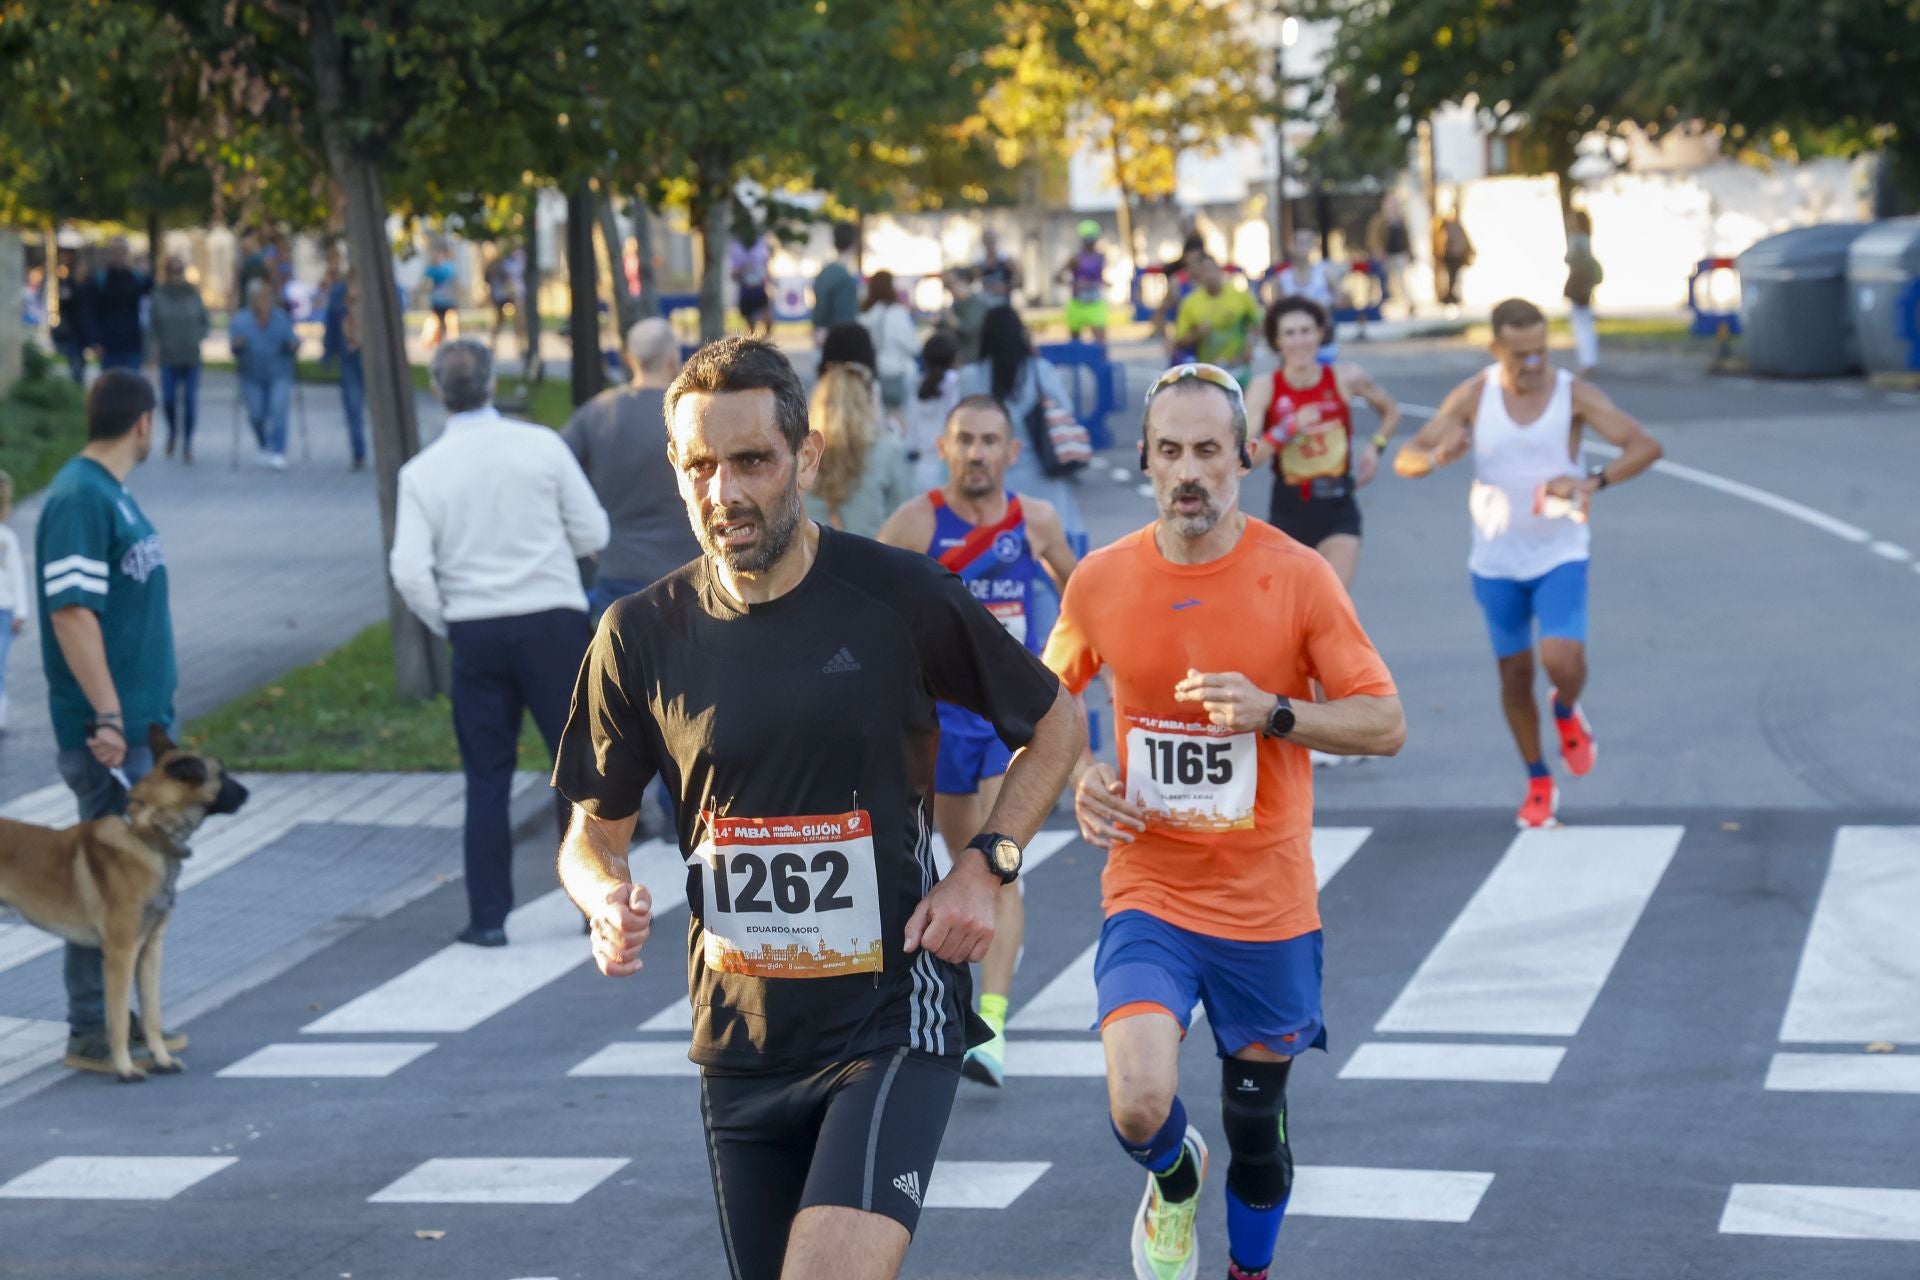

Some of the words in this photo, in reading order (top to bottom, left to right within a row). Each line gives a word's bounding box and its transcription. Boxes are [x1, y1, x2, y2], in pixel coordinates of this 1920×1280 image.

[822, 661, 862, 674] adidas
[1158, 719, 1186, 730] MBA
[1145, 737, 1233, 785] 1165
[735, 827, 771, 839] MBA
[802, 822, 842, 837] GIJÓN
[711, 850, 853, 915] 1262
[746, 925, 790, 934] EDUARDO
[791, 926, 820, 935] MORO
